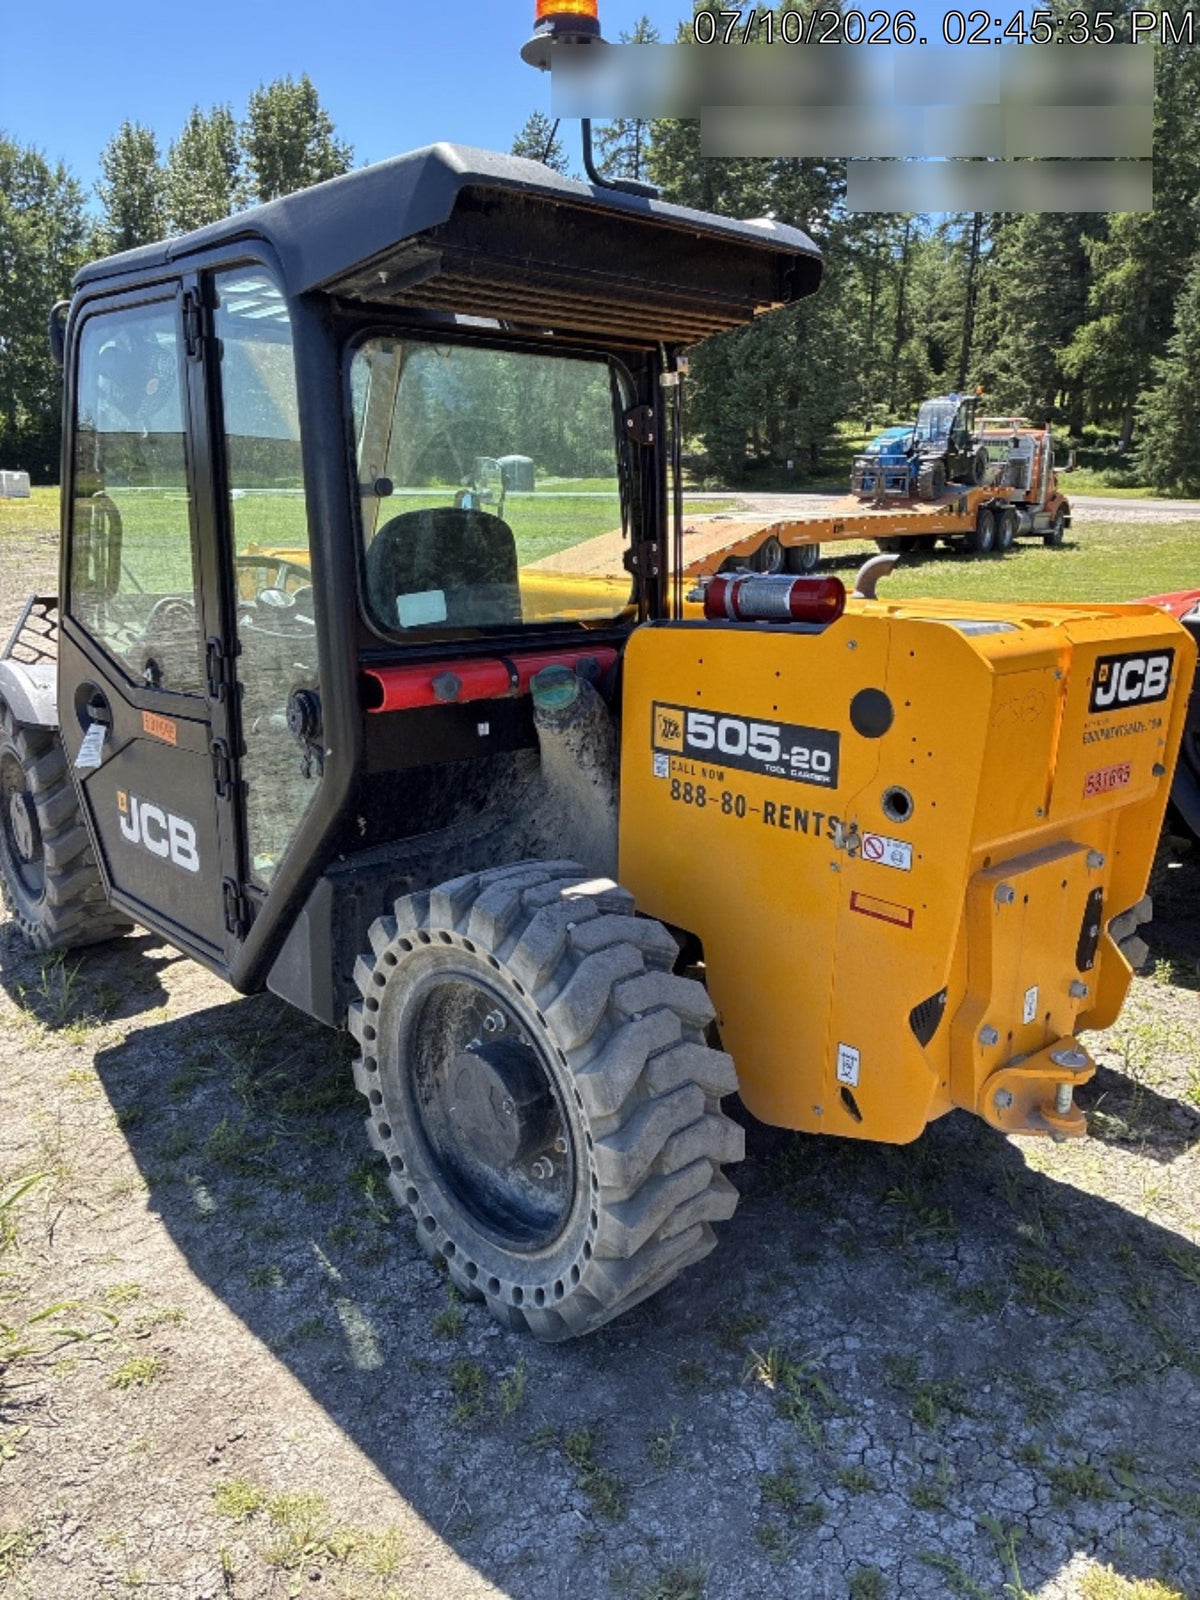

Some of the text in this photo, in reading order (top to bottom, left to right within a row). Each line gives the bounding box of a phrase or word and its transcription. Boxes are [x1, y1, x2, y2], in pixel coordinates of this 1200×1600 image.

[1095, 656, 1169, 705] JCB
[672, 760, 696, 776] CALL
[701, 766, 725, 782] NOW
[120, 795, 200, 872] JCB
[670, 778, 841, 840] 888-80-RENTS
